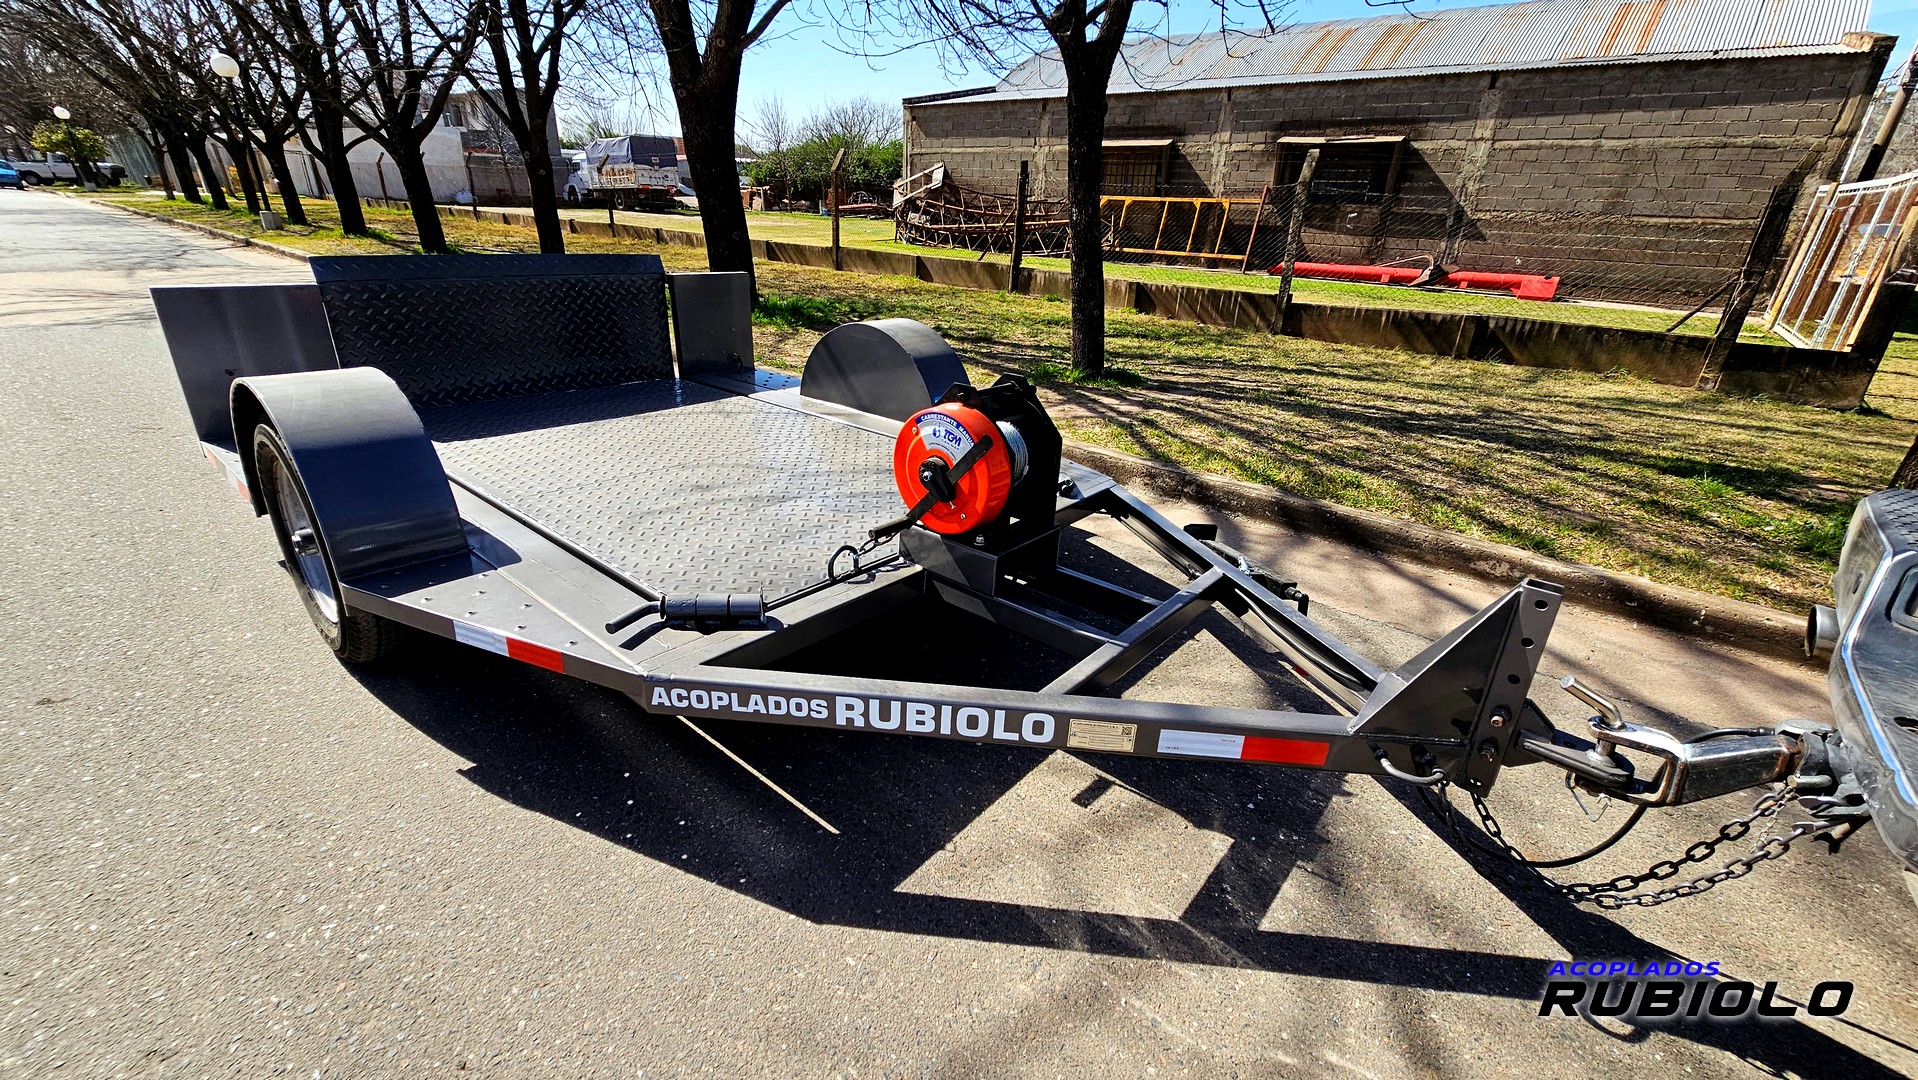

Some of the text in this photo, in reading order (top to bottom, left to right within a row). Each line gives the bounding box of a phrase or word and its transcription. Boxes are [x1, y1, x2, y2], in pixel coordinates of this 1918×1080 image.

[920, 413, 975, 447] CABRESTANTE MANUA
[943, 428, 962, 447] TGM
[651, 687, 1056, 744] ACOPLADOS RUBIOLO
